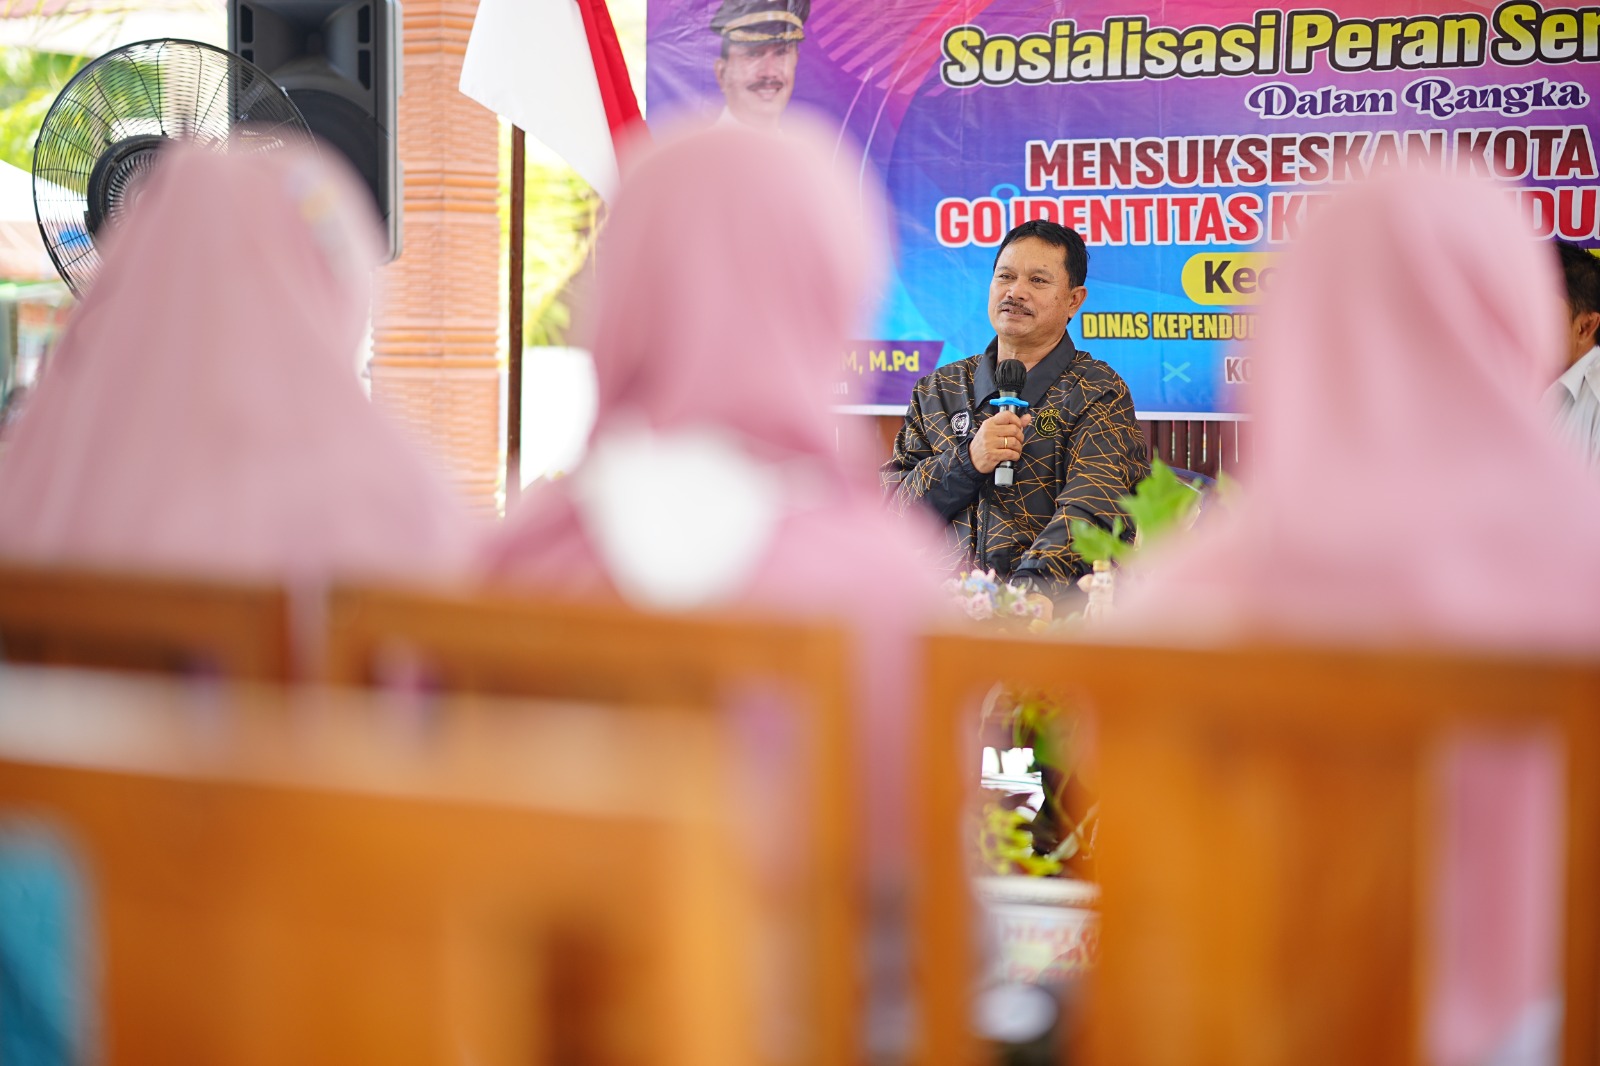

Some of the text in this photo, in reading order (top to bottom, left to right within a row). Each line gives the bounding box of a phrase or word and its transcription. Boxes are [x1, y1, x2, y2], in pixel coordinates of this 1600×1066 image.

[944, 13, 1281, 84] Sosialisasi
[1286, 16, 1486, 73] Peran
[1248, 78, 1588, 118] Dalam Rangka
[1028, 127, 1596, 188] MENSUKSESKAN KOTA
[938, 199, 1004, 246] GO
[1082, 313, 1149, 338] DINAS
[869, 350, 920, 372] M.Pd
